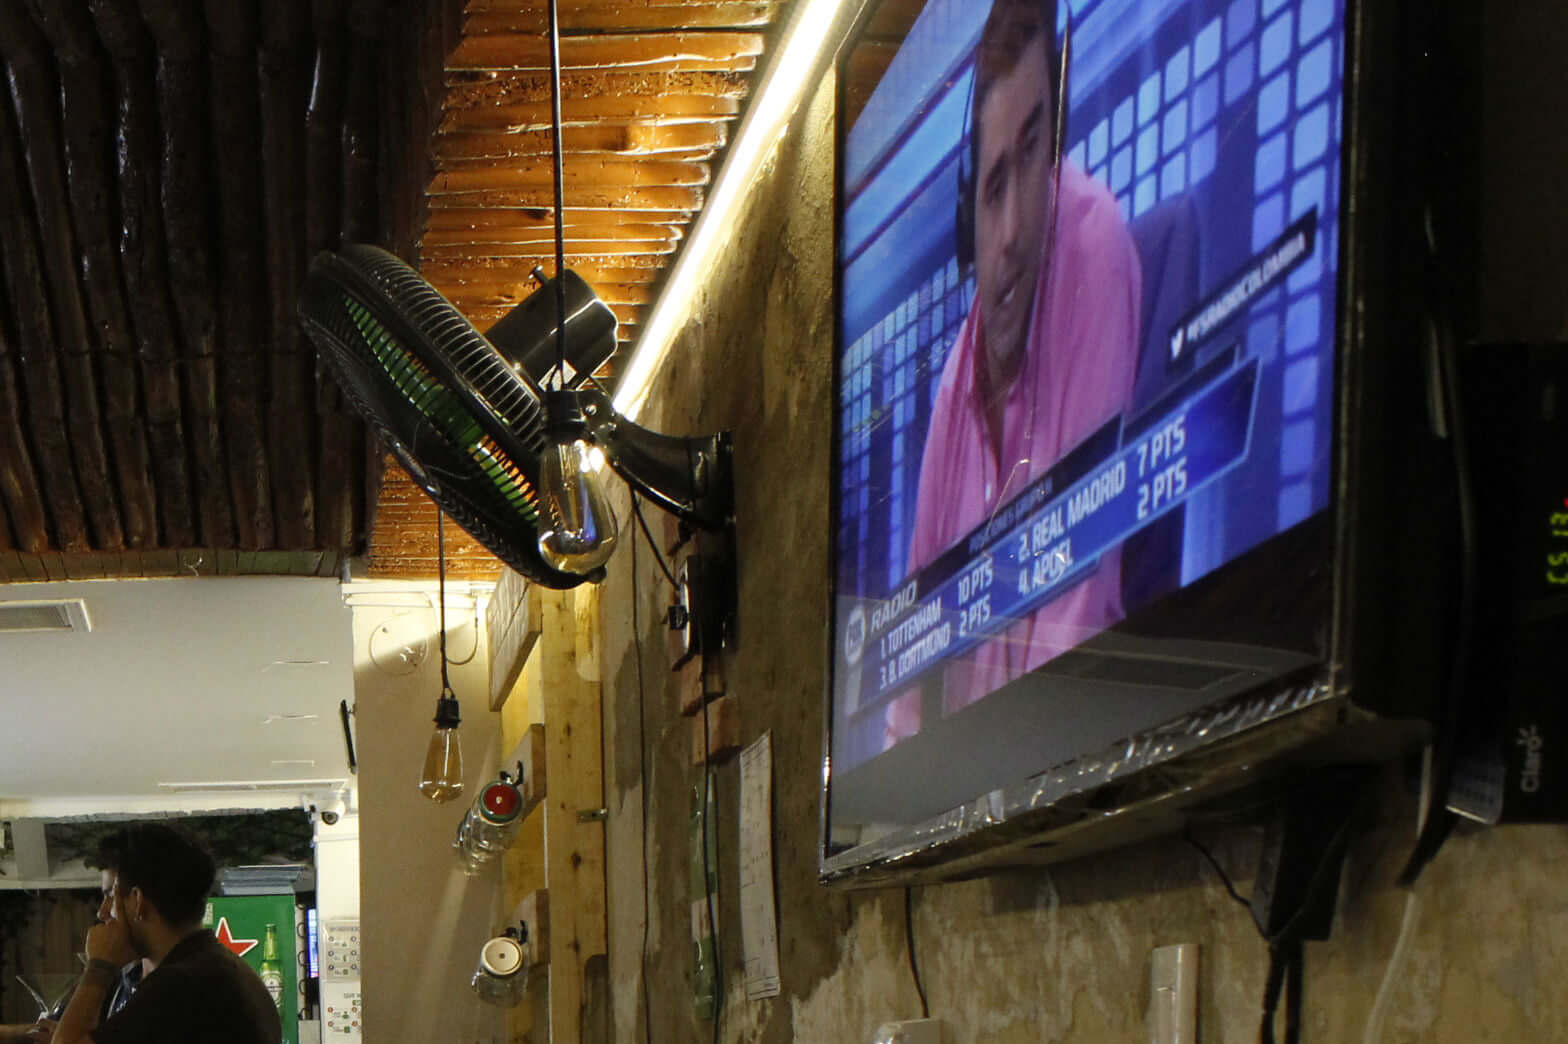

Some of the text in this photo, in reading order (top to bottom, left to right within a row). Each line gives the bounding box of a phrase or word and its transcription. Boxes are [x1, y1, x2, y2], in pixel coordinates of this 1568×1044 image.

[1018, 415, 1186, 563] 2. REAL MADRID 7 PTS
[1018, 457, 1187, 595] 4. APOEL 2 PTS
[871, 580, 917, 632] RADIO
[888, 597, 942, 654] TOTTENHAM
[958, 576, 970, 606] 10
[972, 556, 993, 598] PTS
[898, 621, 950, 677] DORTMUND
[960, 612, 968, 637] 2
[969, 593, 991, 631] PTS
